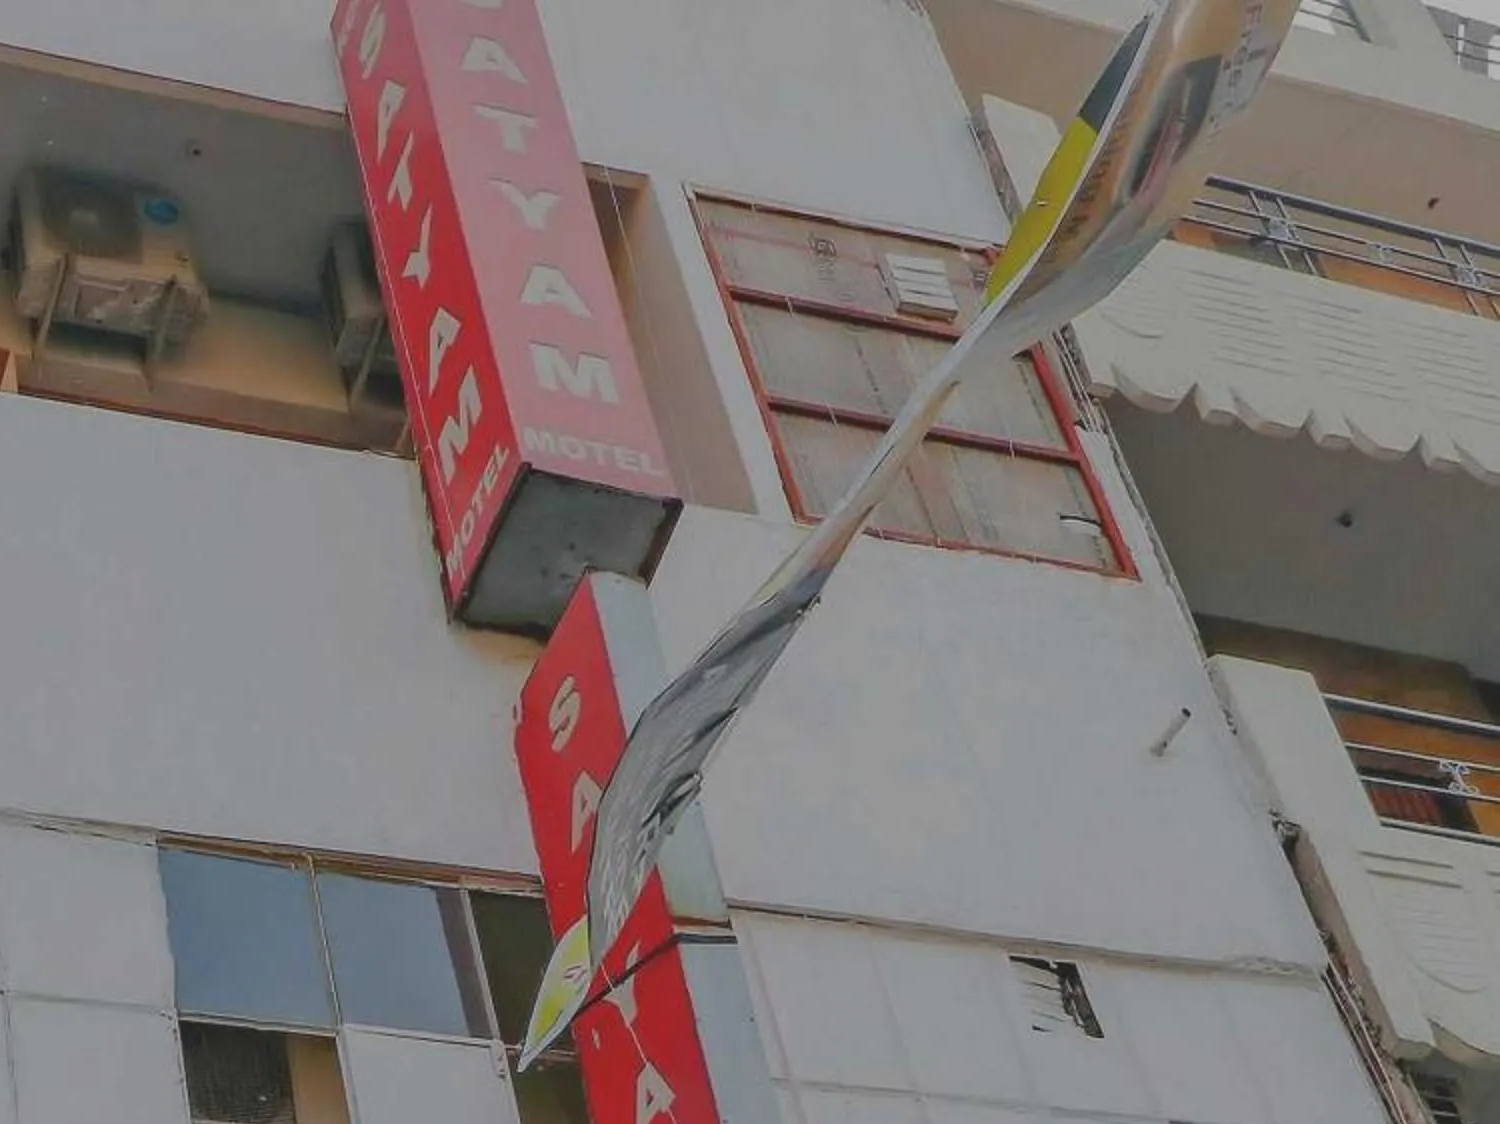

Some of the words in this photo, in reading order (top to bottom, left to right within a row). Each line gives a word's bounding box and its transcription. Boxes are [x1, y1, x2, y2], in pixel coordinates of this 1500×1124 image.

[460, 0, 620, 403] ATYAM
[445, 444, 510, 580] MOTEL
[522, 427, 663, 477] MOTEL
